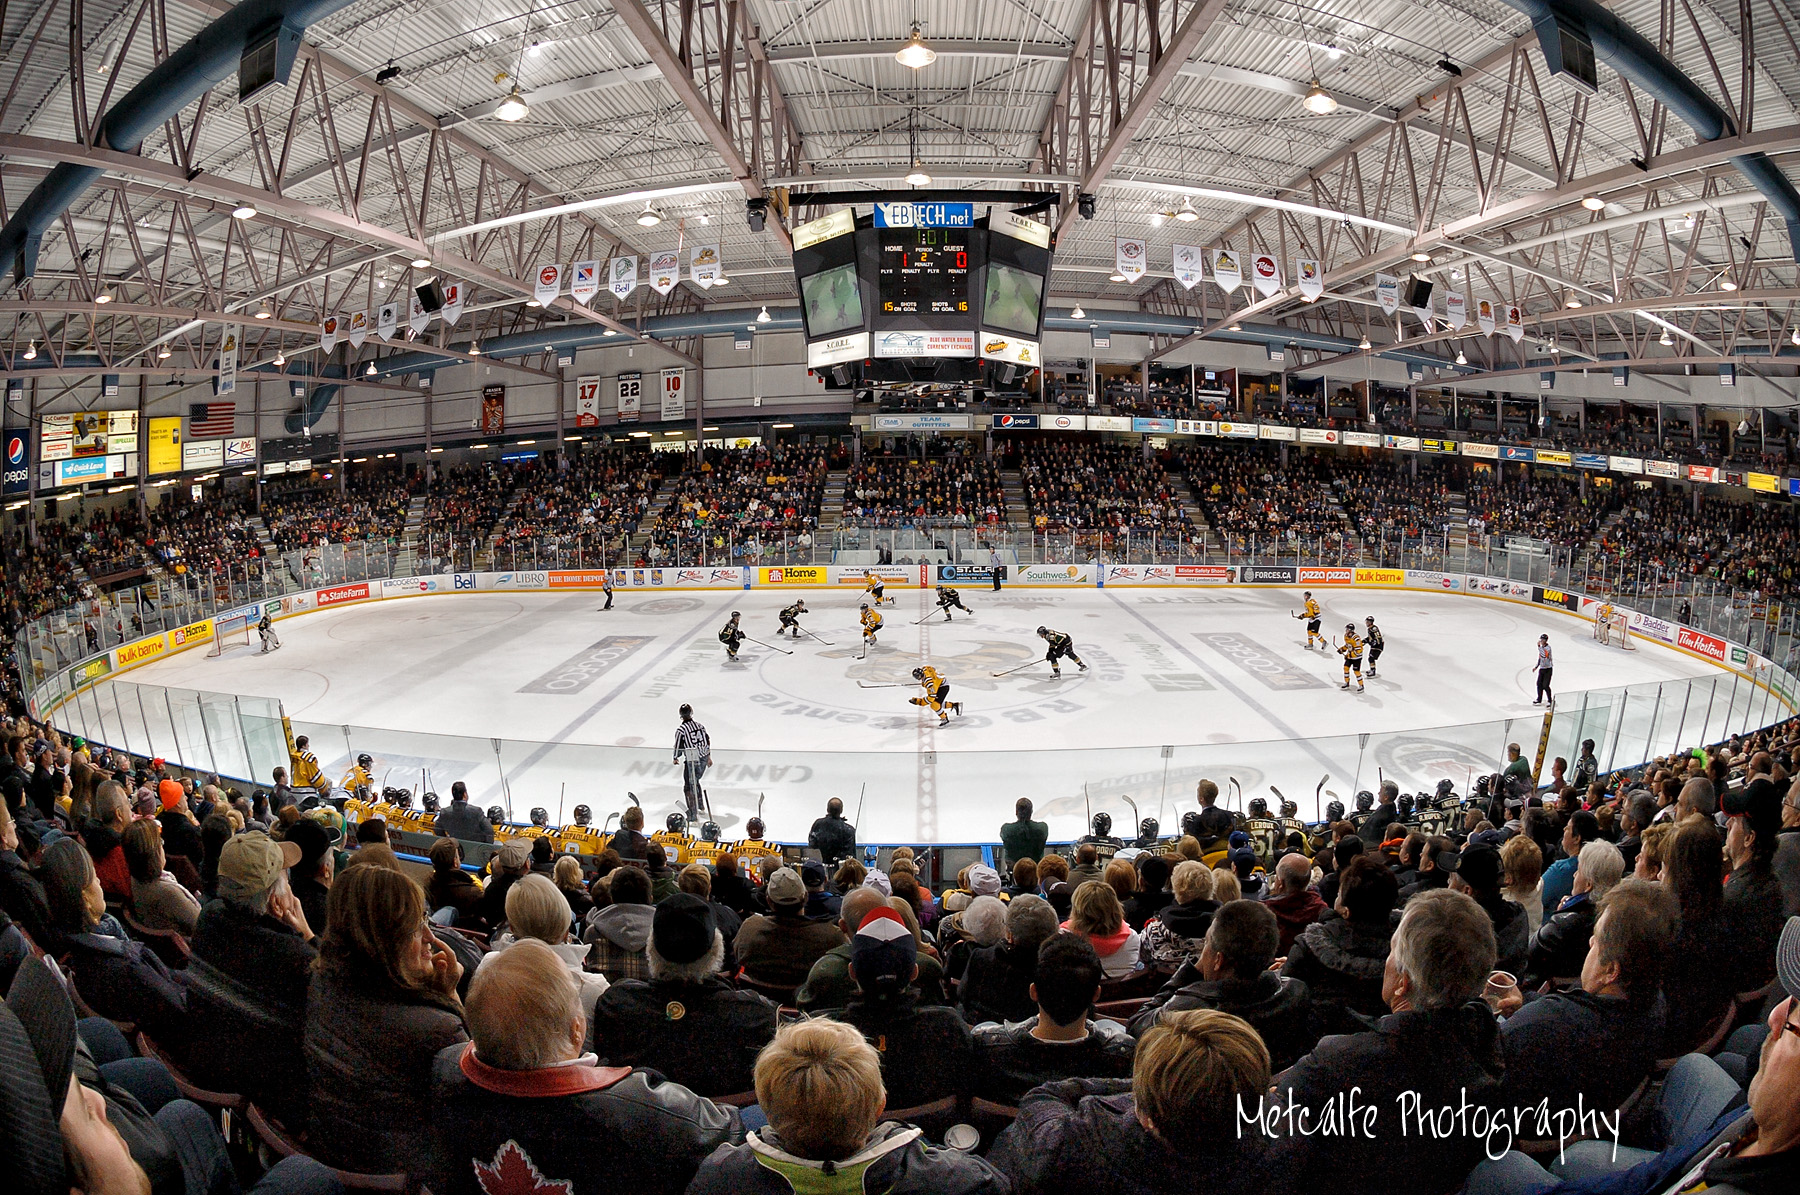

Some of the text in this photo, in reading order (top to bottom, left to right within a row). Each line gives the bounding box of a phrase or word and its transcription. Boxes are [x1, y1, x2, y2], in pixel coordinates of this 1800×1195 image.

[920, 252, 928, 262] 2
[956, 252, 967, 268] 0
[614, 283, 630, 293] Bell
[884, 301, 893, 311] 15
[958, 301, 968, 311] 16
[620, 382, 639, 397] 22
[666, 376, 681, 391] 10
[579, 384, 598, 400] 17
[4, 467, 29, 484] pepsi
[516, 573, 545, 583] LIBRO
[583, 574, 605, 582] DEPOT
[784, 568, 817, 578] Home
[1027, 570, 1072, 579] Southwest
[1300, 571, 1350, 582] pizza pizza
[1356, 572, 1395, 582] bulk barn
[1415, 572, 1443, 580] COGECO
[392, 578, 419, 587] COGECO
[454, 574, 477, 589] Bell
[1543, 589, 1564, 603] VIA
[185, 623, 207, 638] Home
[1643, 616, 1670, 633] Badder
[1679, 630, 1694, 647] Tim
[1694, 636, 1724, 660] Hortons
[118, 642, 158, 664] bulk barn
[1207, 635, 1285, 674] COGECO
[74, 660, 101, 683] SUBWAY
[545, 648, 627, 690] COGECO
[690, 731, 703, 743] 54
[623, 760, 814, 783] CANAIAN
[1251, 821, 1274, 829] LEROUX
[658, 836, 687, 846] CHAPMAN
[689, 849, 718, 857] KUZMYK
